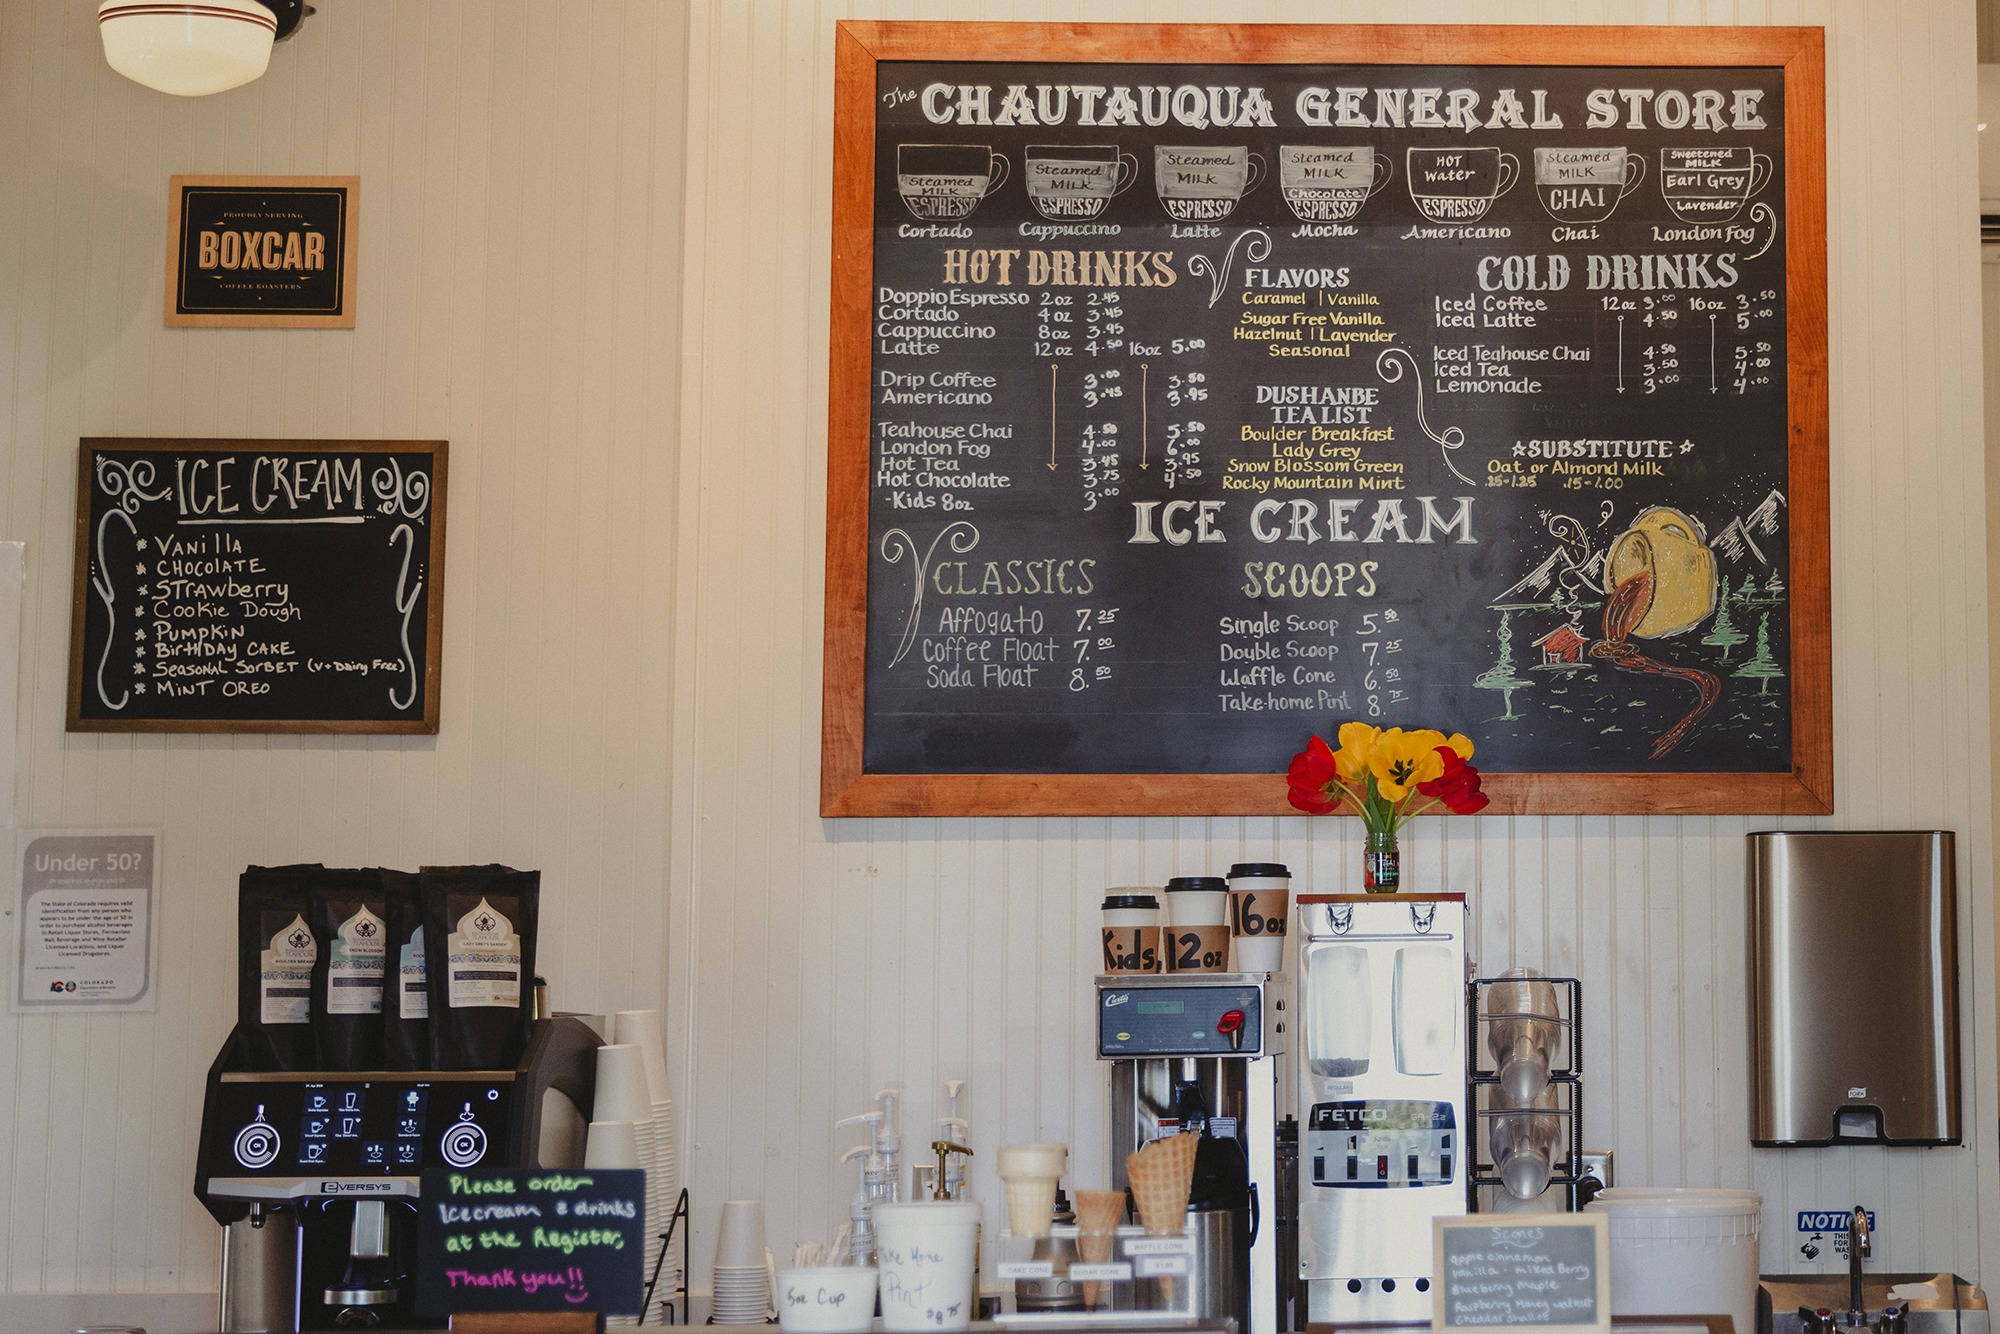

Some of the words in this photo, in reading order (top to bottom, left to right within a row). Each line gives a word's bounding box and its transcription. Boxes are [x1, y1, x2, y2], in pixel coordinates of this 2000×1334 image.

[883, 88, 917, 109] The
[921, 83, 1277, 130] CHAUTAUQUA
[1296, 88, 1563, 134] GENERAL
[1586, 89, 1767, 133] STORE
[1167, 154, 1234, 166] Steamed
[1291, 152, 1354, 164] Steamed
[1436, 155, 1461, 167] HOT
[1546, 152, 1611, 164] Steamed
[1685, 158, 1722, 168] MILK
[1035, 164, 1101, 175] Steamed
[1304, 168, 1348, 179] MILK
[1559, 167, 1595, 179] MILK
[909, 177, 974, 187] Steamed
[1050, 179, 1093, 190] MILK
[1178, 173, 1217, 185] MILK
[1667, 175, 1701, 188] Earl
[1707, 173, 1744, 190] Grey
[921, 187, 959, 196] MILK
[1288, 187, 1362, 199] Chocolate
[1551, 188, 1605, 210] CHAI
[907, 197, 976, 215] ESPRESSO
[1040, 198, 1102, 214] ESPRESSO
[1169, 200, 1232, 218] ESPRESSO
[1295, 200, 1357, 219] ESPRESSO
[1422, 199, 1485, 218] ESPRESSO
[899, 224, 972, 238] Cortado
[1019, 222, 1121, 241] Cappuccino
[1170, 224, 1221, 239] Latte
[1292, 223, 1358, 238] Mocha
[1401, 225, 1511, 240] Americano
[1552, 227, 1600, 242] Chai
[1652, 226, 1722, 242] London
[1725, 226, 1755, 244] Fog
[199, 231, 325, 270] BOXCAR
[943, 249, 1020, 286] HOT
[1028, 250, 1177, 287] DRINKS
[1477, 255, 1571, 292] COLD
[1587, 254, 1739, 290] DRINKS
[1245, 268, 1349, 288] FLAVORS
[880, 288, 948, 306] Doppio
[950, 289, 1030, 306] Espresso
[1242, 292, 1305, 305] Caramel
[1328, 294, 1379, 305] Vanilla
[1435, 293, 1476, 312] Iced
[1483, 296, 1547, 311] Coffee
[878, 306, 959, 322] Cortado
[1241, 312, 1289, 326] Sugar
[1293, 313, 1327, 325] Free
[1330, 312, 1385, 325] Vanilla
[1436, 312, 1475, 328] Iced
[1483, 313, 1536, 327] Latte
[878, 323, 996, 341] Cappuccino
[1234, 328, 1302, 340] Hazelnut
[1320, 329, 1396, 342] Lavender
[881, 340, 940, 355] Latte
[1269, 345, 1350, 356] Seasonal
[1434, 346, 1468, 361] Iced
[1472, 346, 1548, 360] Teahouse
[1553, 346, 1590, 361] Chai
[1434, 361, 1471, 377] Iced
[1477, 363, 1511, 376] Tea
[881, 371, 924, 388] Drip
[930, 371, 997, 386] Coffee
[1437, 378, 1542, 393] Lemonade
[882, 389, 992, 405] Americano
[1257, 386, 1379, 404] DUSHANBE
[1271, 407, 1315, 424] TEA
[1321, 407, 1372, 424] LIST
[878, 422, 965, 439] Teahouse
[969, 423, 1012, 439] Chai
[1241, 426, 1306, 441] Boulder
[1312, 426, 1394, 441] Breakfast
[881, 440, 952, 456] London
[958, 441, 991, 458] Fog
[1272, 443, 1314, 459] Lady
[1320, 444, 1361, 460] Grey
[1528, 439, 1672, 458] SUBSTITUTE
[881, 457, 916, 472] Hot
[922, 458, 959, 471] Tea
[1228, 460, 1270, 472] Snow
[1274, 459, 1349, 473] Blossom
[1353, 460, 1403, 473] Green
[1488, 460, 1522, 474] Oat
[1530, 462, 1548, 473] or
[1552, 461, 1618, 475] Almond
[1623, 461, 1664, 475] Milk
[176, 458, 239, 515] ICE
[252, 456, 364, 512] CREAM
[878, 472, 911, 487] Hot
[916, 472, 1010, 488] Chocolate
[1223, 476, 1270, 493] Rocky
[1274, 476, 1352, 489] Mountain
[1359, 477, 1405, 489] Mint
[1128, 499, 1226, 545] ICE
[1249, 495, 1480, 546] CREAM
[933, 559, 1096, 596] CLASSICS
[1242, 561, 1378, 599] SCOOPS
[240, 602, 300, 622] Dough
[938, 607, 1044, 636] Affogato
[1220, 612, 1280, 638] Single
[1286, 616, 1340, 634] Scoop
[247, 642, 295, 655] CAKE
[923, 638, 994, 663] Coffee
[1004, 638, 1060, 662] Float
[1220, 642, 1280, 664] Double
[1286, 641, 1339, 662] Scoop
[927, 666, 976, 688] Soda
[984, 666, 1038, 687] Float
[1220, 666, 1286, 688] Waffle
[1294, 666, 1336, 684] Cone
[1317, 690, 1352, 712] Pint
[35, 854, 99, 871] Under
[107, 853, 142, 871] 50?
[1319, 1109, 1387, 1121] FETCO
[450, 1174, 516, 1195] Please
[528, 1177, 593, 1192] order
[575, 1201, 635, 1219] drinks
[446, 1234, 473, 1252] at
[479, 1230, 521, 1249] the
[1492, 1227, 1543, 1239] Scones
[446, 1270, 516, 1287] Thank
[817, 1288, 845, 1311] Cup
